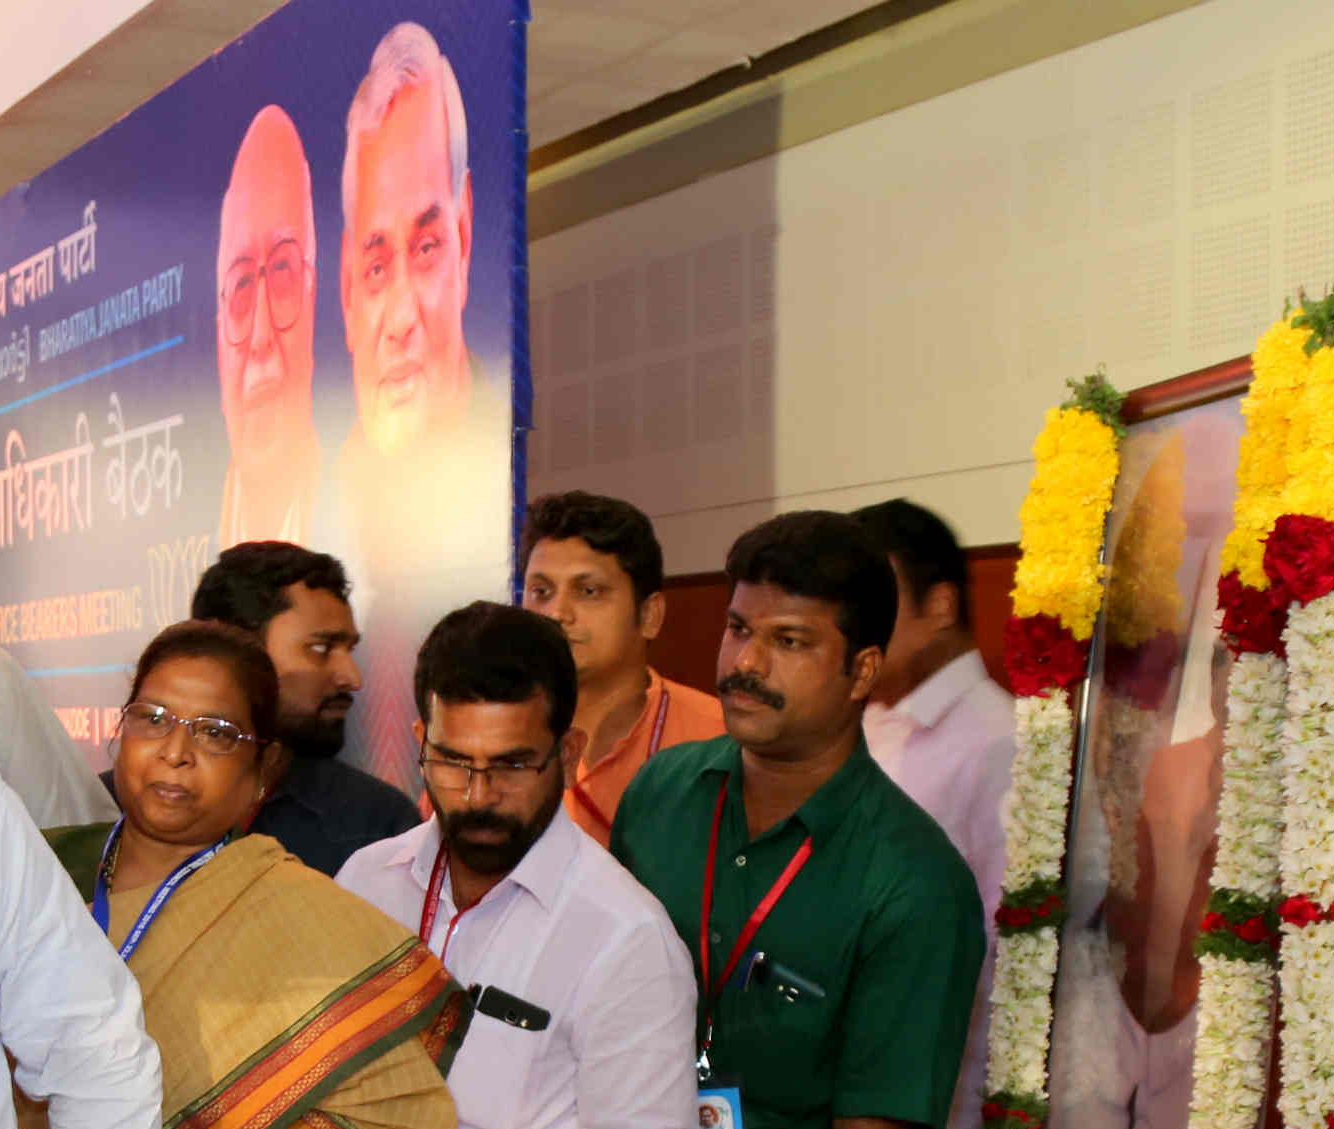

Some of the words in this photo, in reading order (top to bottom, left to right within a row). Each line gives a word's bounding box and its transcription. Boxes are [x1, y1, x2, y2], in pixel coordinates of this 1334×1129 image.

[8, 245, 55, 308] जनता
[57, 199, 98, 284] पार्टी
[39, 306, 96, 362] BHARATIYA
[97, 285, 139, 337] JANATA
[141, 263, 185, 318] PARTY
[102, 391, 185, 521] बैठक
[80, 584, 142, 637] MEETING
